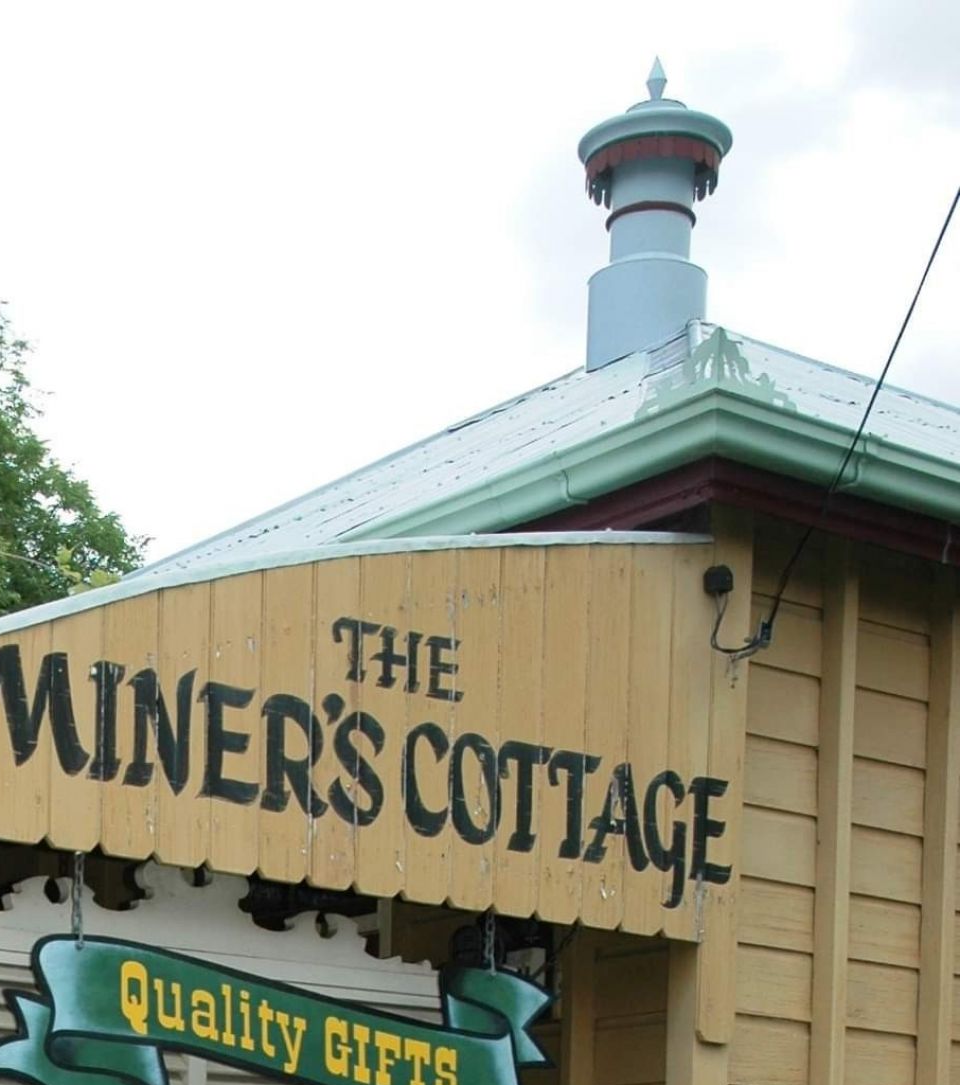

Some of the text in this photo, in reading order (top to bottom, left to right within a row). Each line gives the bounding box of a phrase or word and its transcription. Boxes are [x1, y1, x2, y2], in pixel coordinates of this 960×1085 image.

[332, 616, 464, 702] THE
[403, 721, 733, 909] COTTAGE
[120, 960, 307, 1074] Quality
